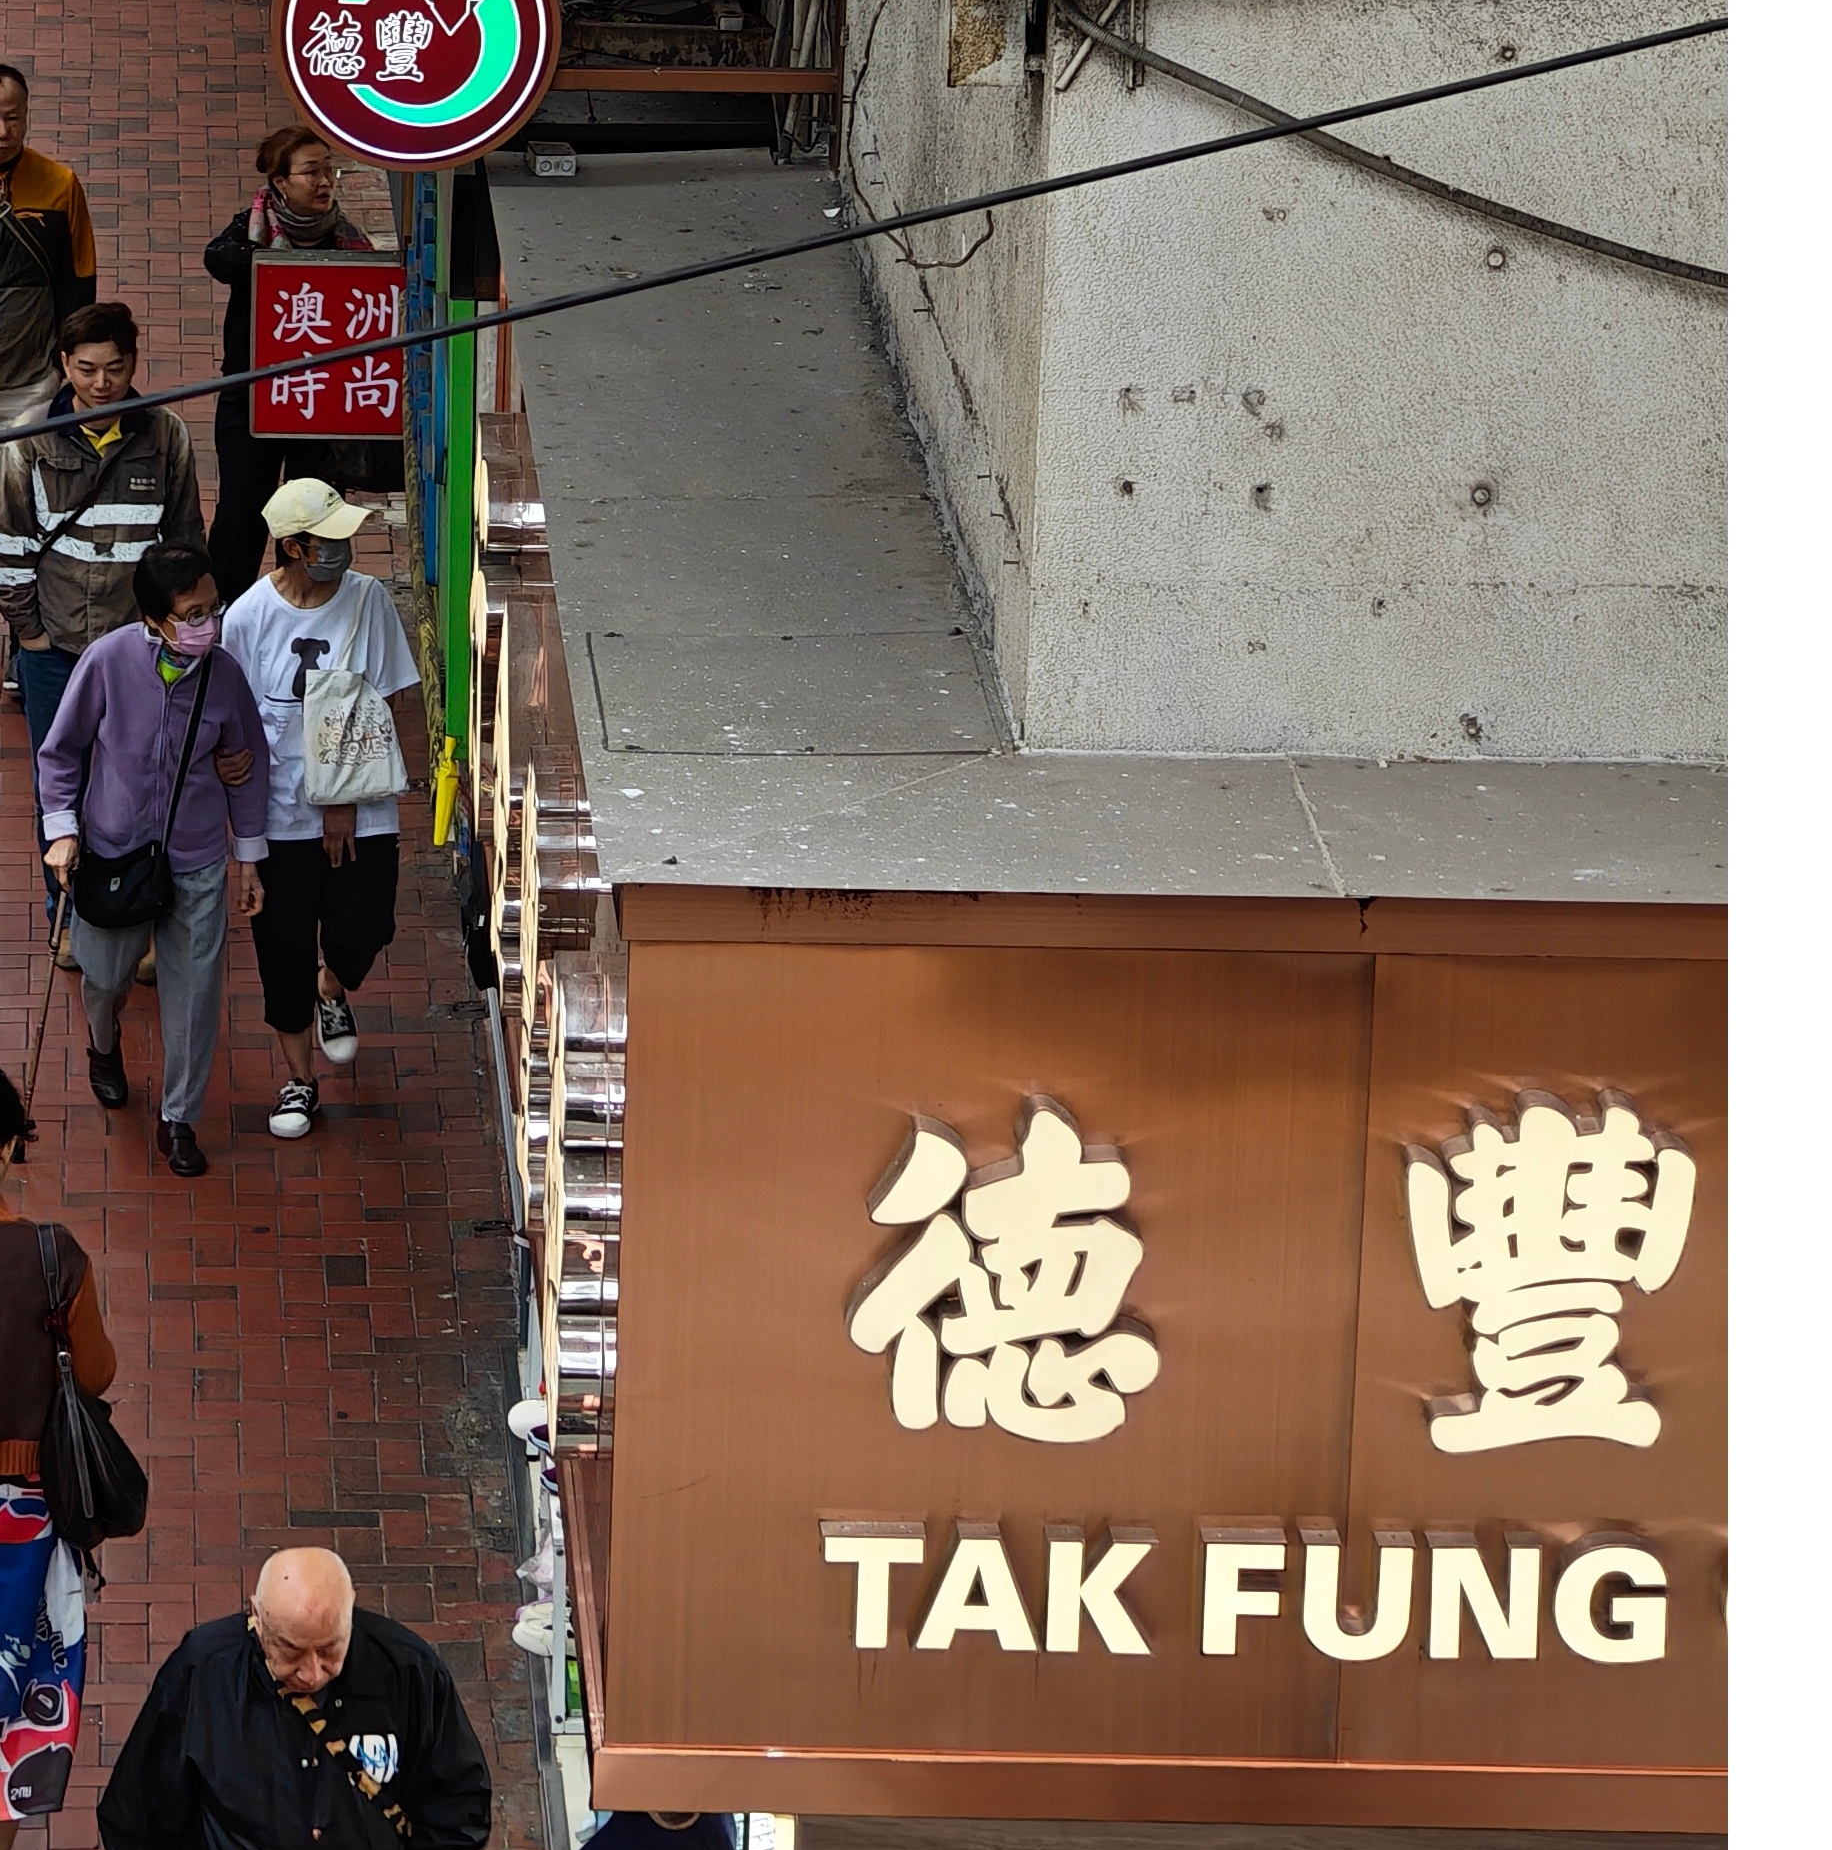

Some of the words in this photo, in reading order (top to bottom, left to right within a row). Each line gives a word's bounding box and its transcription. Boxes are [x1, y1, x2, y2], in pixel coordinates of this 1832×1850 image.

[302, 9, 434, 83] 德豐
[272, 281, 399, 345] 澳洲
[270, 352, 399, 421] 時尚
[848, 1104, 1697, 1453] 德豐
[822, 1533, 1153, 1655] TAK
[1199, 1539, 1668, 1663] FUNG
